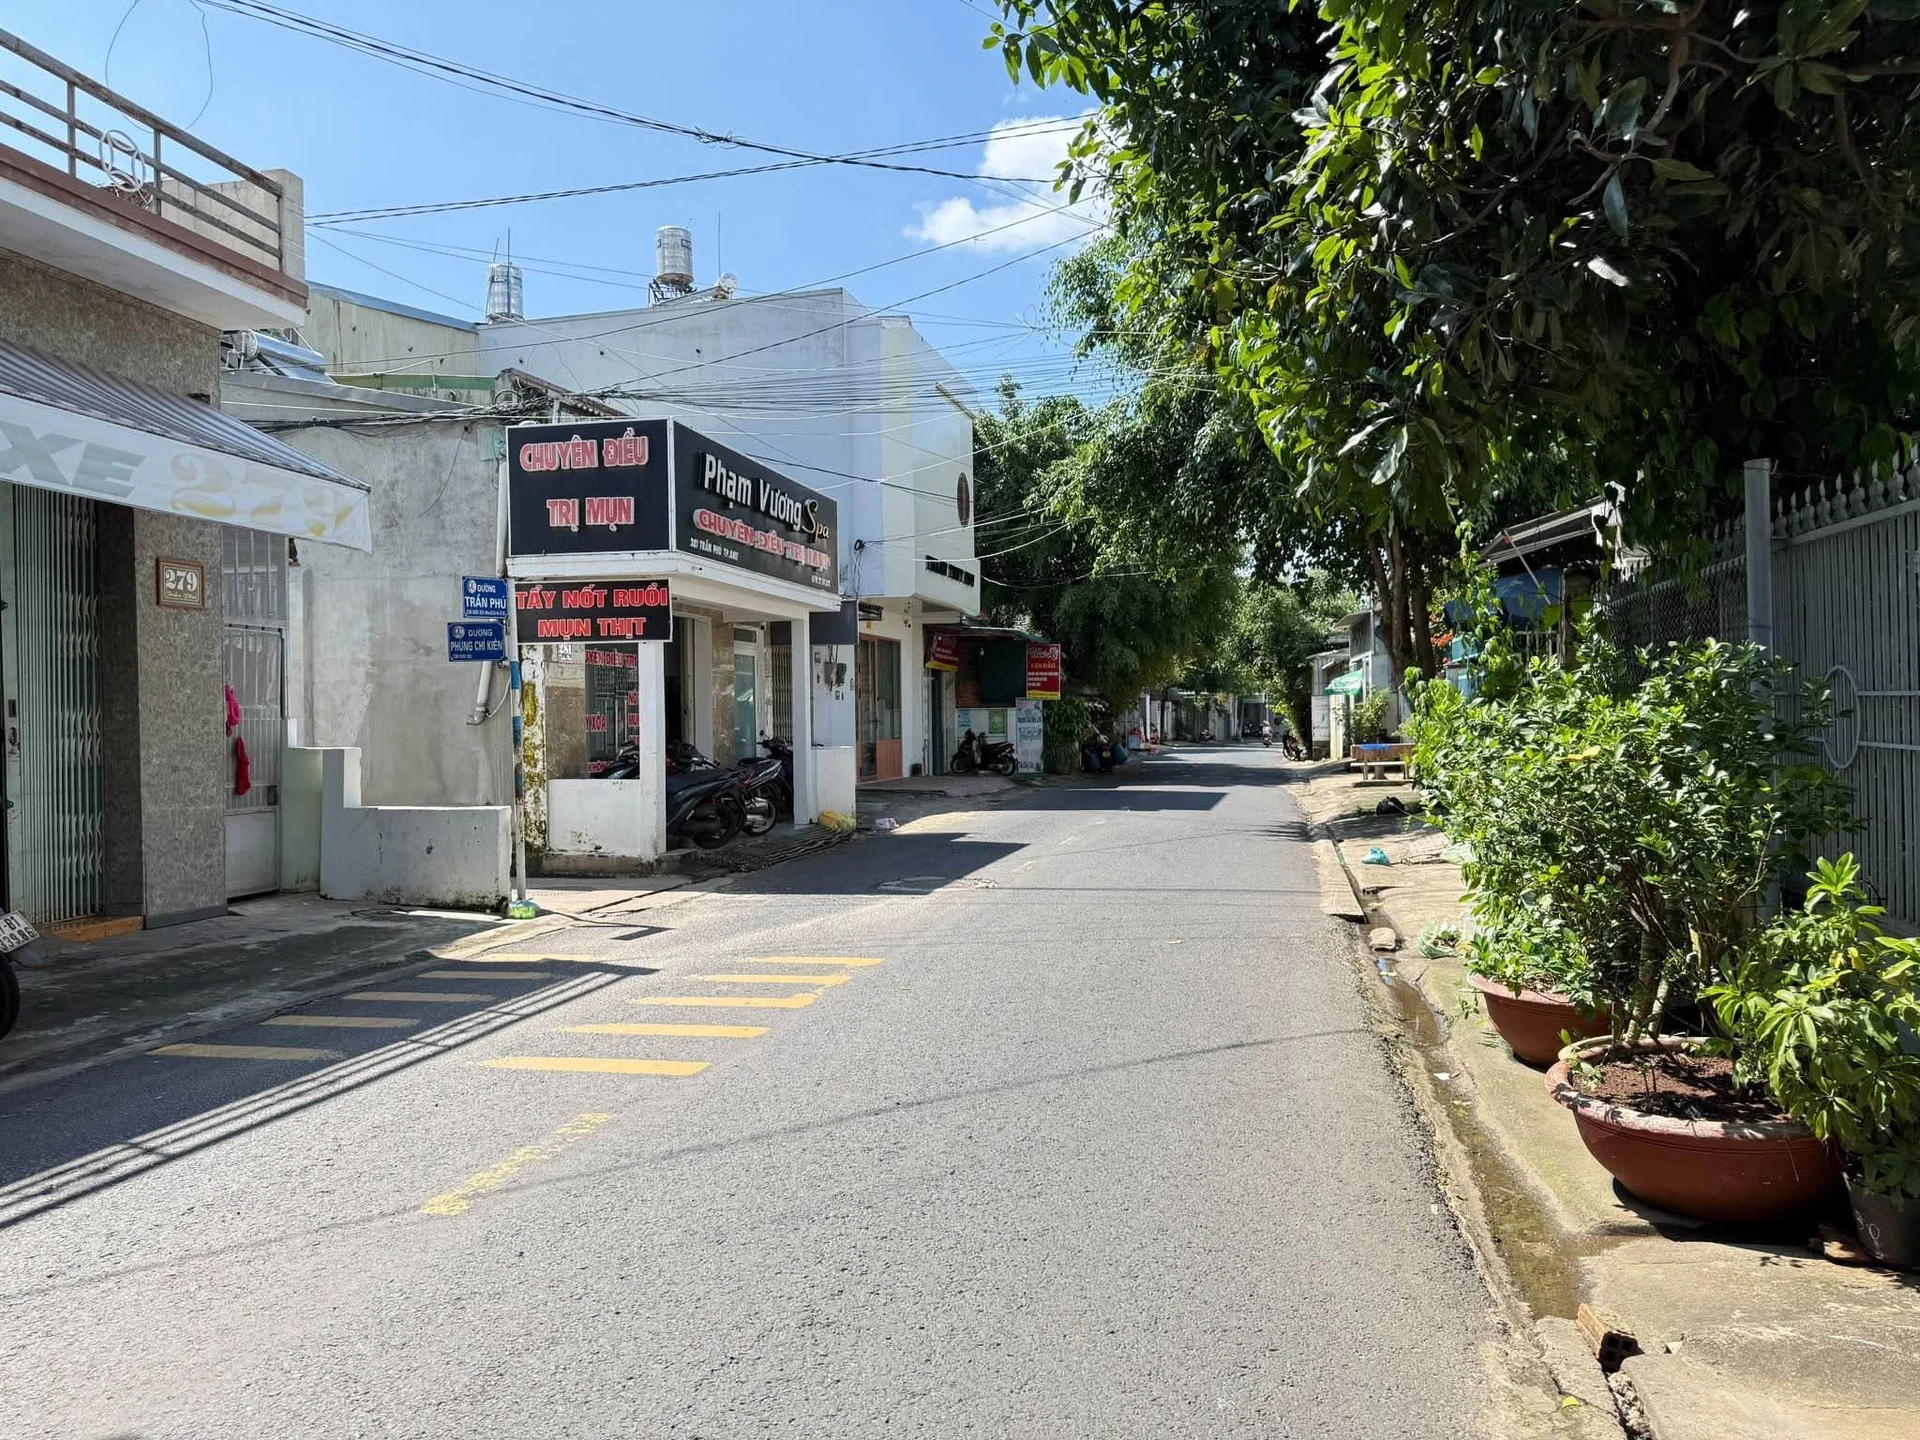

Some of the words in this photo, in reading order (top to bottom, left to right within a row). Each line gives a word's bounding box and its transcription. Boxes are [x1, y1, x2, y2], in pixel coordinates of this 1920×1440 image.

[520, 434, 599, 472] CHUYÊN
[602, 427, 649, 467] ĐIỀU
[704, 453, 752, 509] Phạm
[760, 479, 802, 531] Vương
[802, 499, 829, 542] Spa
[546, 498, 580, 532] TRỊ
[585, 497, 635, 532] MỤN
[693, 509, 754, 546] CHUYÊN
[165, 569, 198, 592] 279
[562, 583, 608, 608] NỐT
[613, 582, 668, 607] RUỒI
[489, 595, 507, 609] PHÚ
[537, 618, 592, 640] MỤN
[597, 617, 647, 639] THỊT
